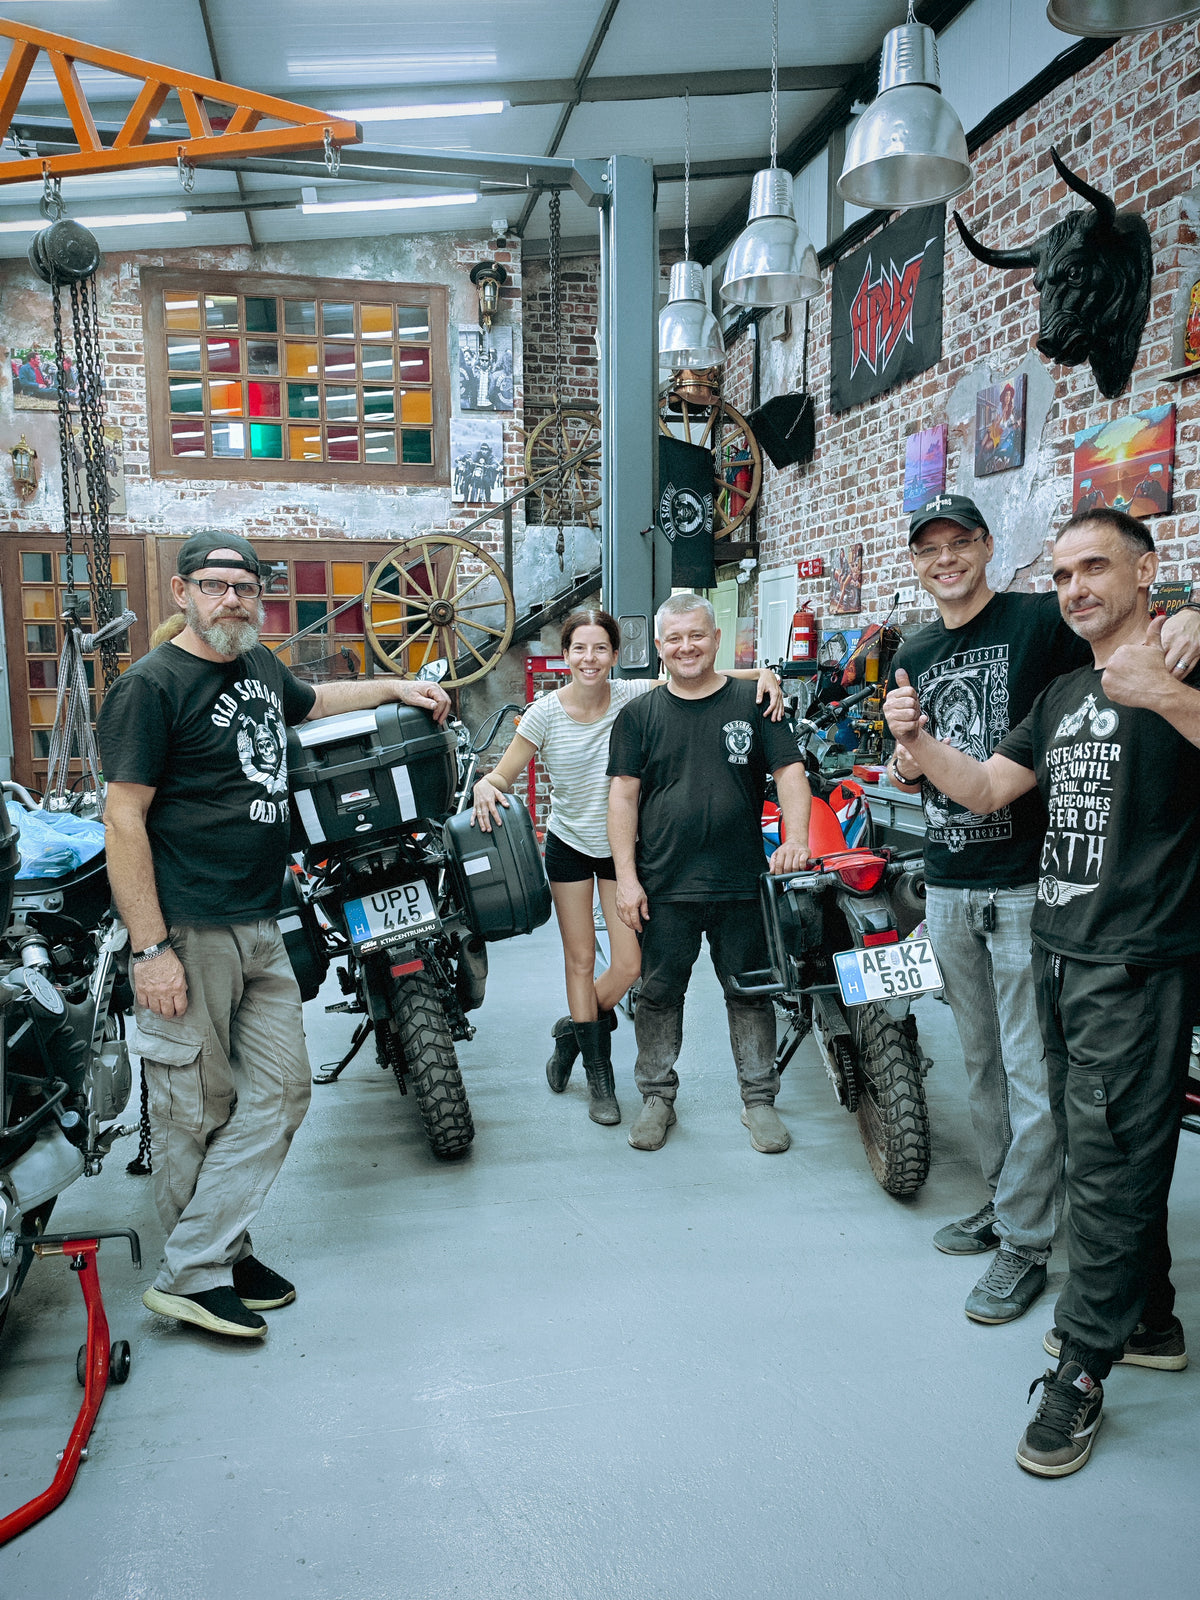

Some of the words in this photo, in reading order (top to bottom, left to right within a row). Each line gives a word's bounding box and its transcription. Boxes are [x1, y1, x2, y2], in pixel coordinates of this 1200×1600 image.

[850, 236, 938, 381] АРИЯ
[661, 486, 676, 518] SCHO
[664, 522, 676, 538] OLD
[211, 693, 238, 727] OLD
[1083, 781, 1100, 794] OF
[249, 799, 277, 824] OLD
[1084, 810, 1109, 832] OF
[371, 885, 420, 913] UPD
[354, 924, 365, 935] H
[384, 904, 423, 931] 445
[380, 923, 436, 946] KTMCENTRUM.HU
[862, 949, 891, 974] AE
[900, 942, 932, 967] KZ
[847, 981, 859, 994] H
[880, 967, 923, 994] 530
